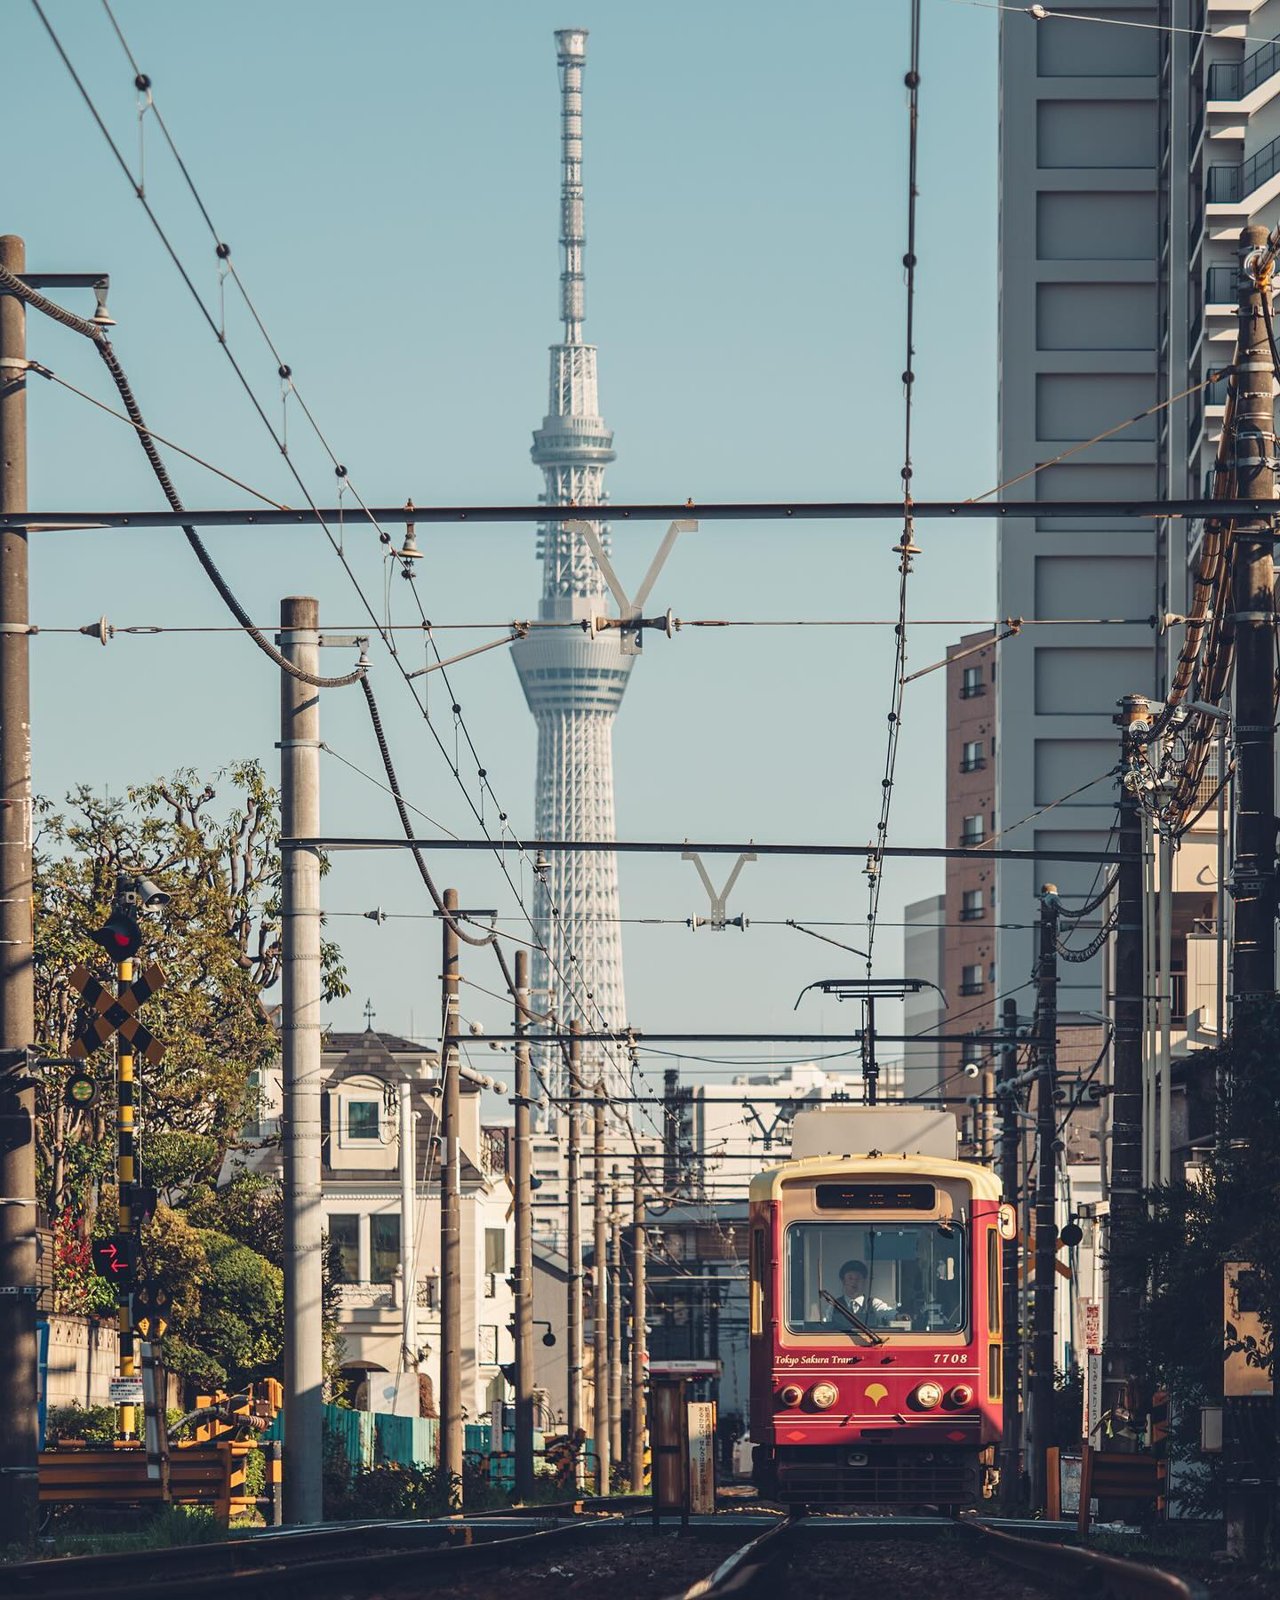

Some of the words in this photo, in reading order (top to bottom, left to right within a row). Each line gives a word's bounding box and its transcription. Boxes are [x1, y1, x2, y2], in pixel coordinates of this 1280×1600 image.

[775, 1354, 799, 1367] Tokyo
[801, 1354, 829, 1364] Sakura
[934, 1353, 968, 1364] 7708
